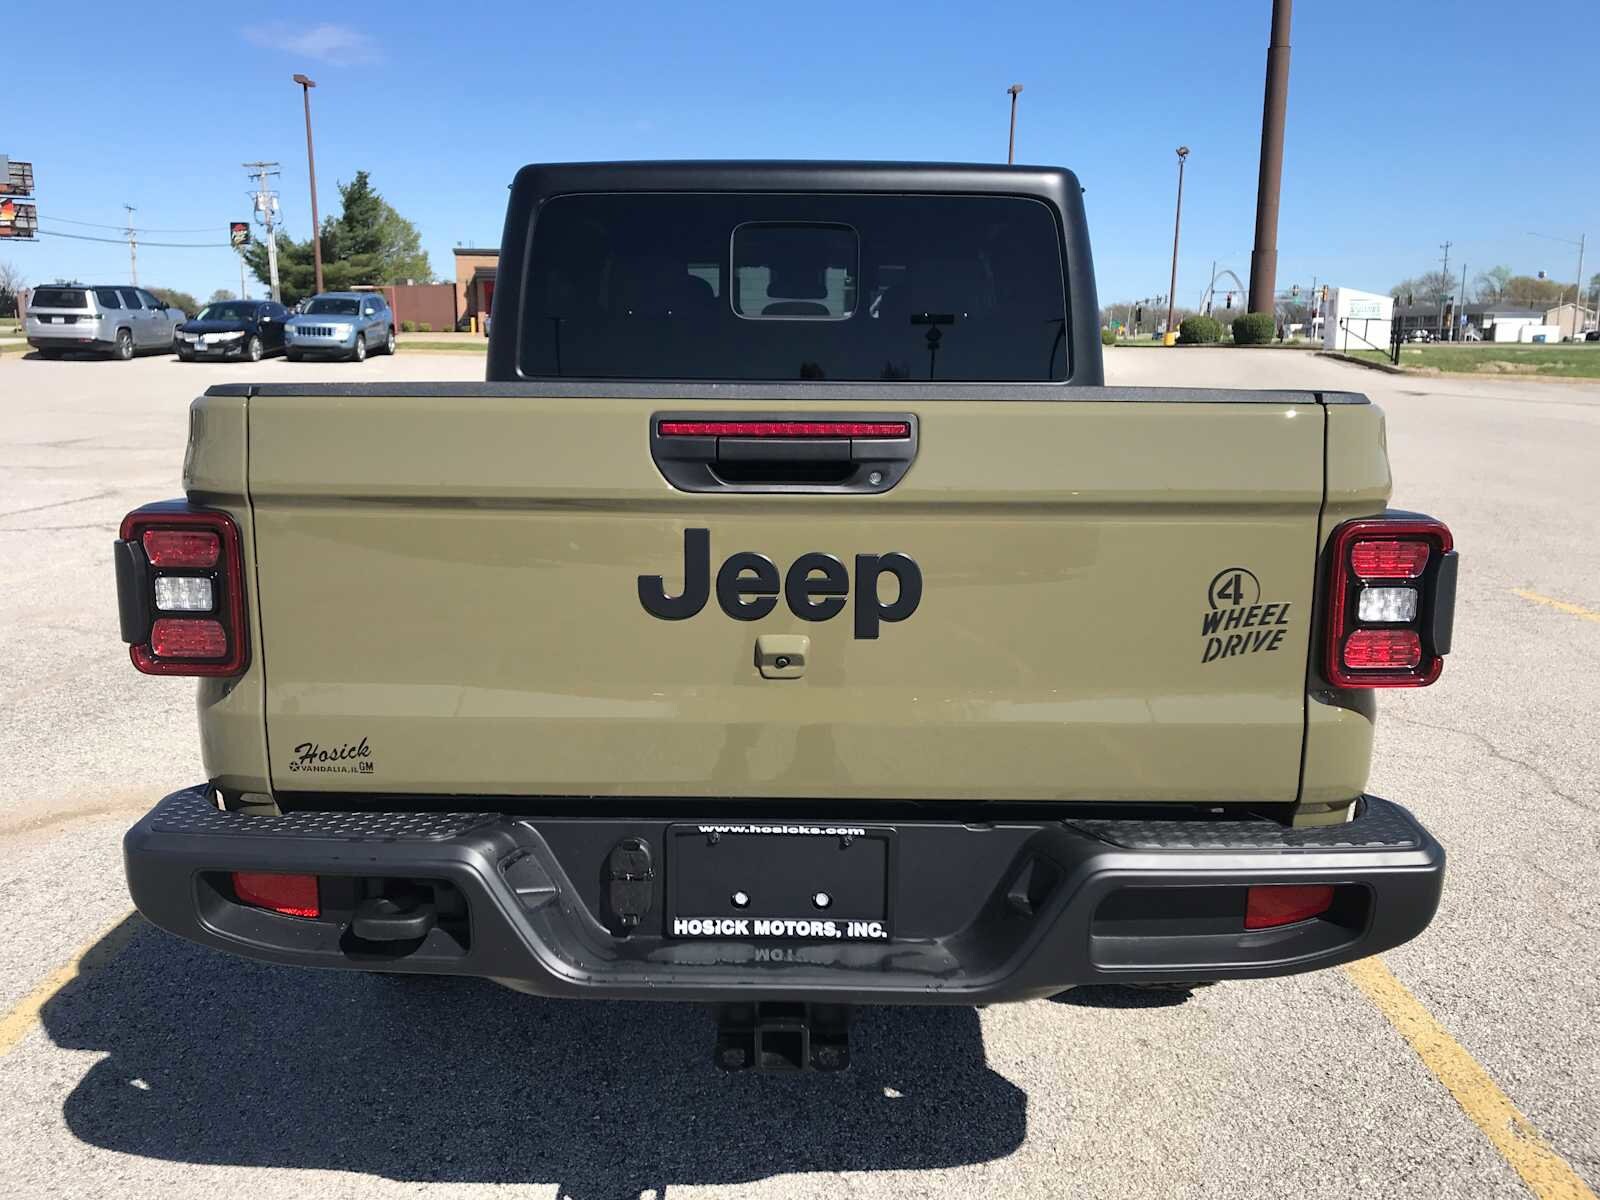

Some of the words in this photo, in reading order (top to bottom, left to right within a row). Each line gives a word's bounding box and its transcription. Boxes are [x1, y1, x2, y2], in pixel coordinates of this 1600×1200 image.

[637, 527, 923, 640] Jeep
[1216, 574, 1244, 606] 4
[1201, 602, 1291, 637] WHEEL
[1201, 629, 1288, 664] DRIVE
[294, 736, 372, 765] Hosick
[360, 761, 374, 772] GM
[698, 824, 866, 836] www.hosicks.com
[673, 919, 750, 936] HOSICK
[753, 920, 842, 938] MOTORS,
[846, 921, 888, 939] INC.
